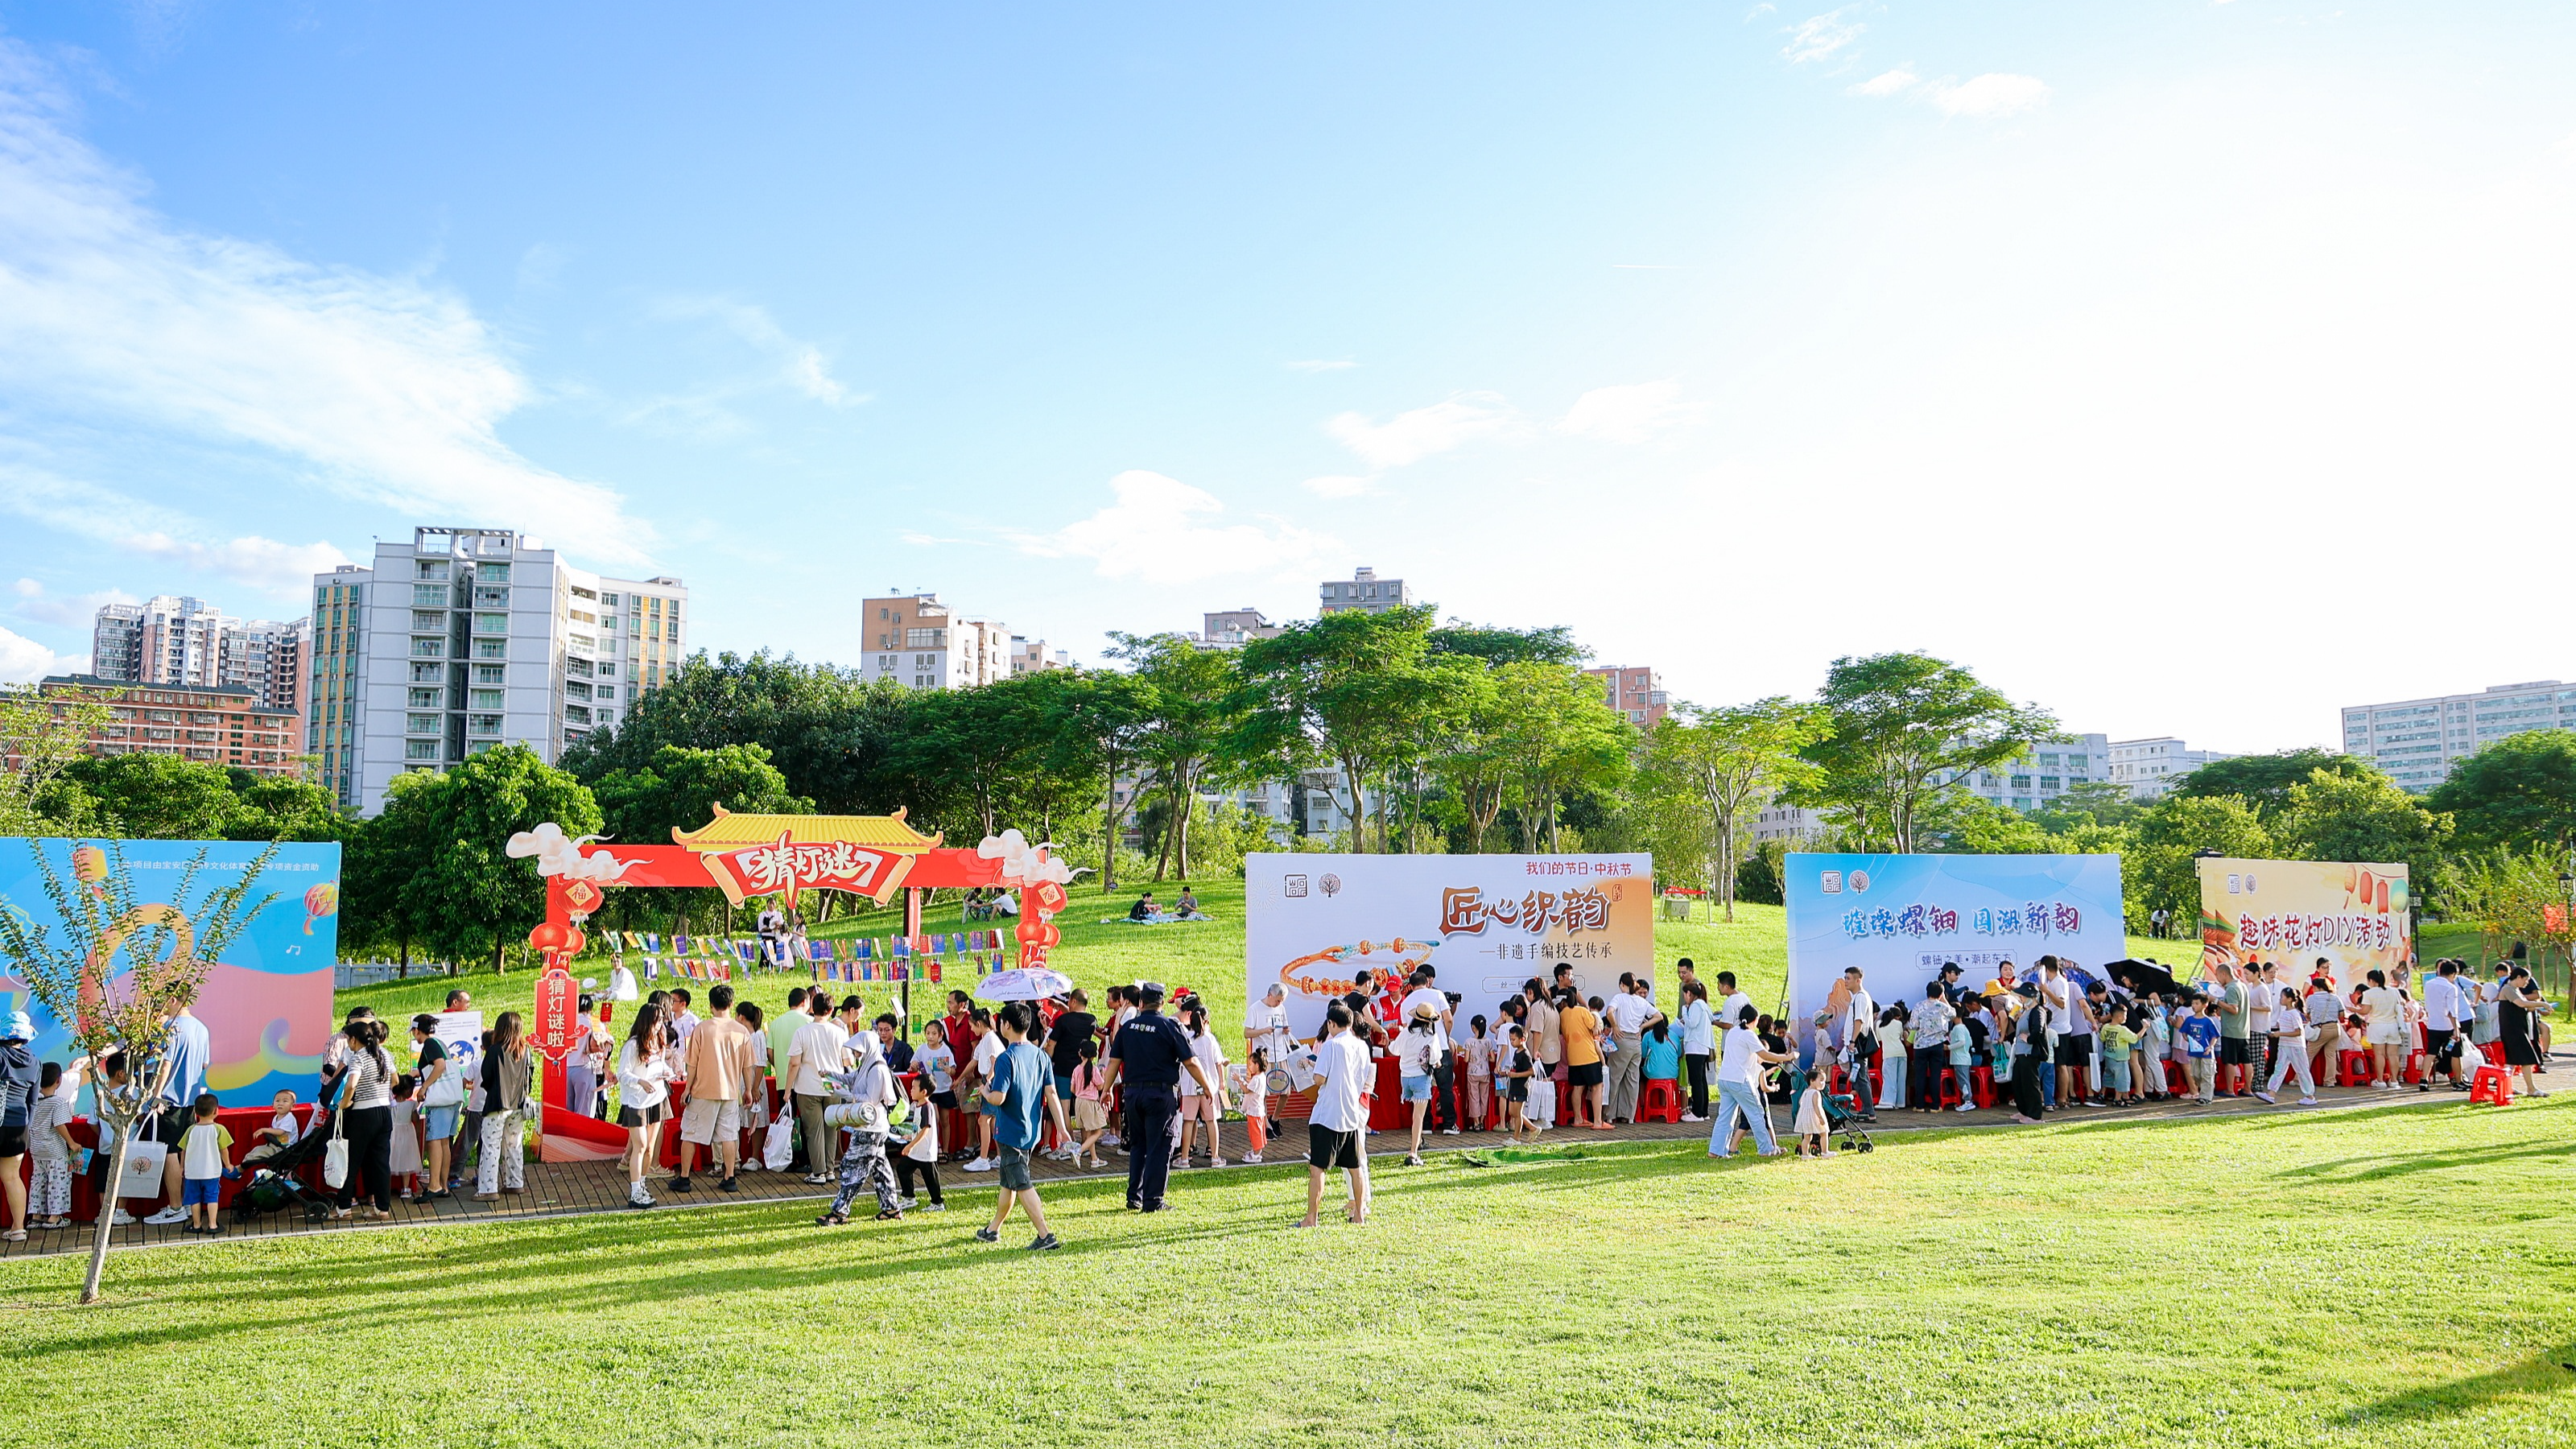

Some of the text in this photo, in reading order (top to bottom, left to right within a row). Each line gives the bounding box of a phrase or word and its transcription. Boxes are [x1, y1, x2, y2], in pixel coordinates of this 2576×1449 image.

[747, 831, 868, 901] 猜灯谜
[1525, 861, 1632, 876] 我们的节日·中秋节
[572, 886, 586, 900] 福
[1042, 888, 1055, 901] 福
[1439, 886, 1609, 936] 匠心织韵
[1842, 901, 2081, 936] 璀璨螺钿 国潮新韵
[2240, 912, 2392, 949] 趣味花灯DIY活动
[547, 978, 566, 1047] 猜灯谜啦
